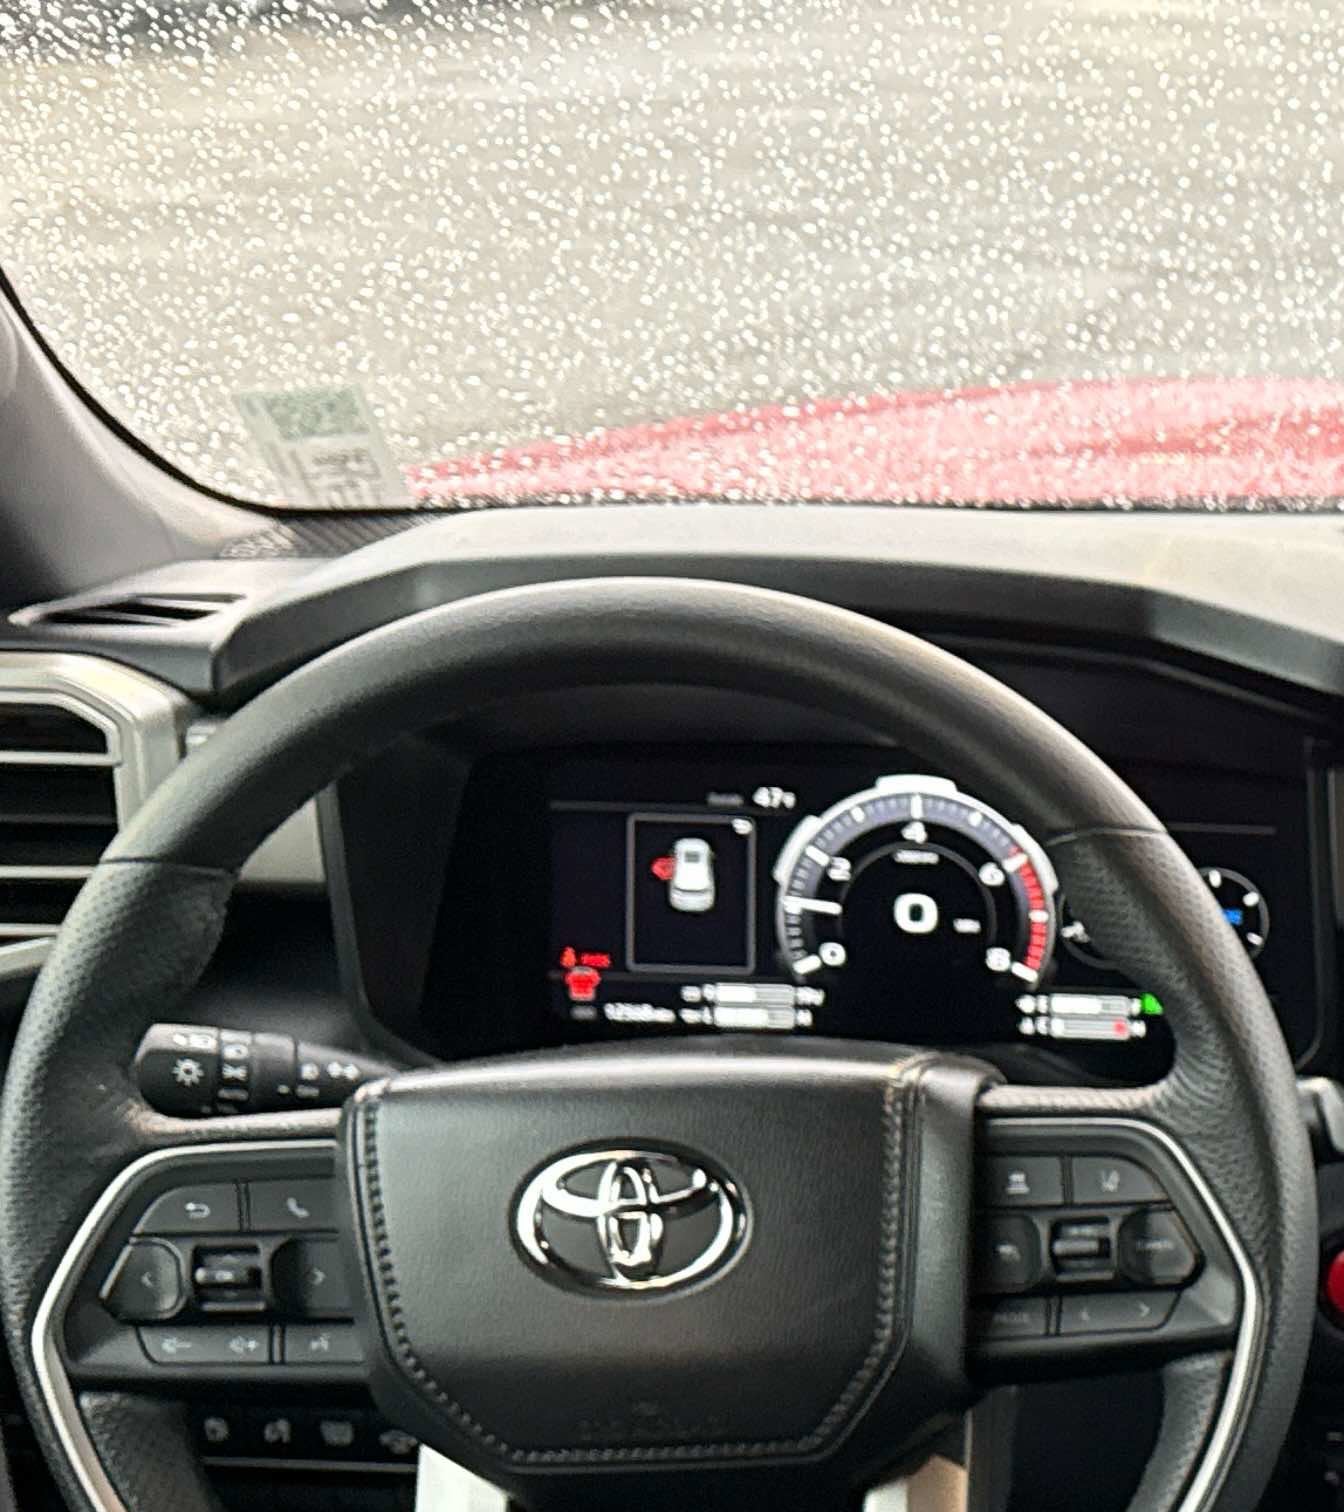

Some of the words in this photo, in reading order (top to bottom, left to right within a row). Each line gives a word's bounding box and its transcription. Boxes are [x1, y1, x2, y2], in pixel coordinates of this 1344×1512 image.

[902, 821, 928, 844] 4
[827, 856, 851, 881] 2
[978, 861, 1005, 887] 6
[893, 892, 939, 934] 0
[818, 941, 846, 967] 0
[985, 946, 1012, 972] 8
